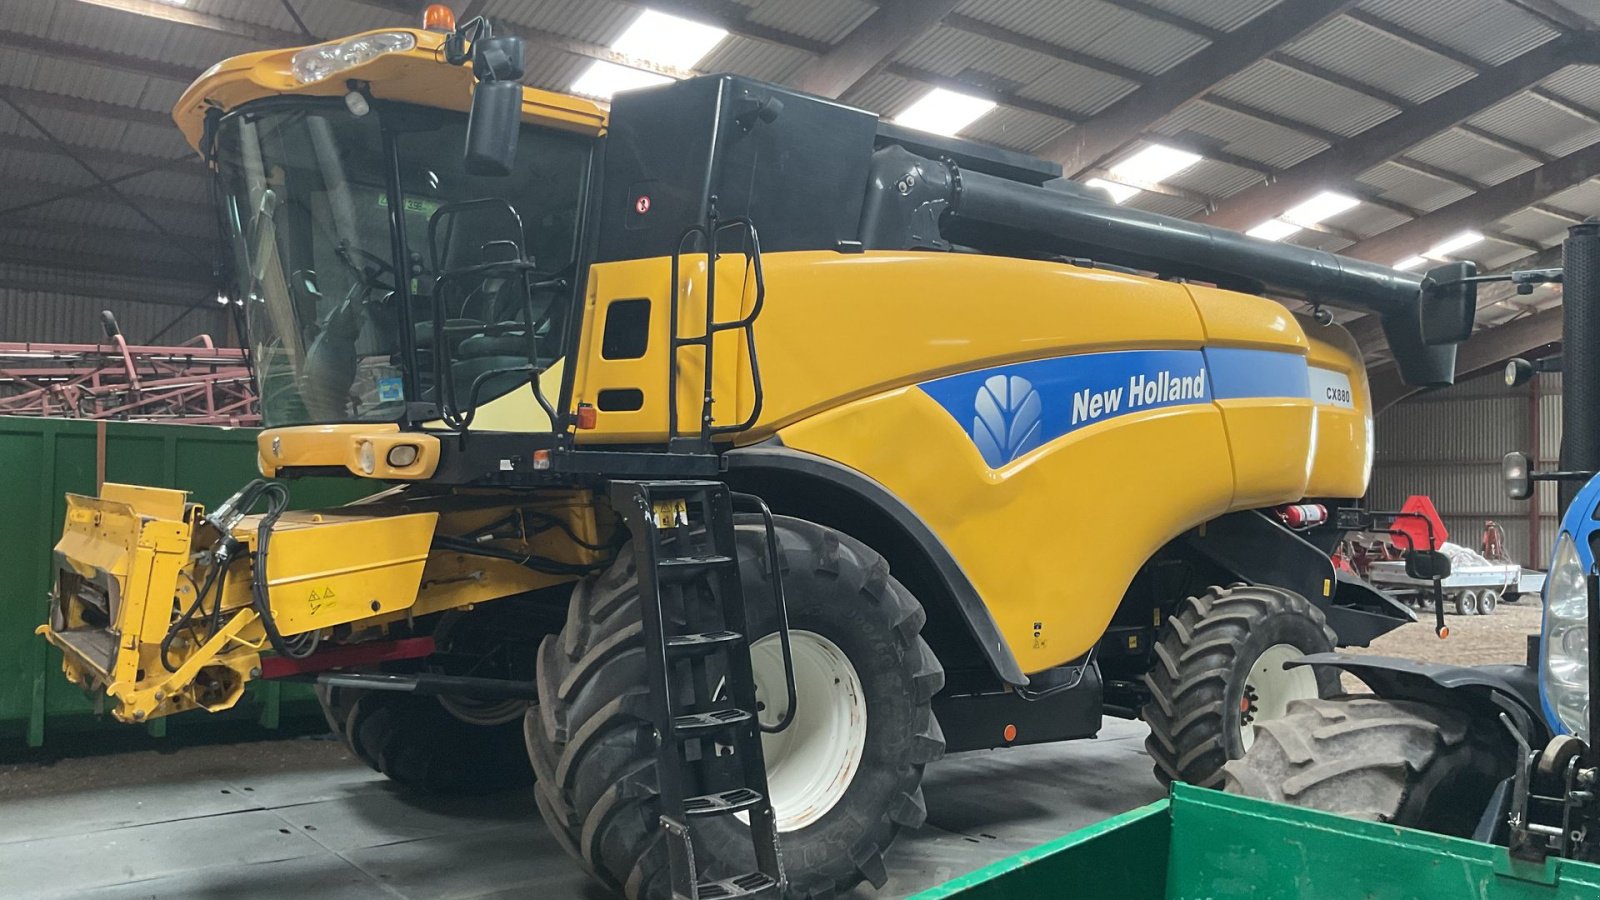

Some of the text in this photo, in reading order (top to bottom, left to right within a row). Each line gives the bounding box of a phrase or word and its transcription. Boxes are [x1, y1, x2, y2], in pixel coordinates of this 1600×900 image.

[1072, 368, 1205, 425] New Holland
[1326, 387, 1350, 403] CX880
